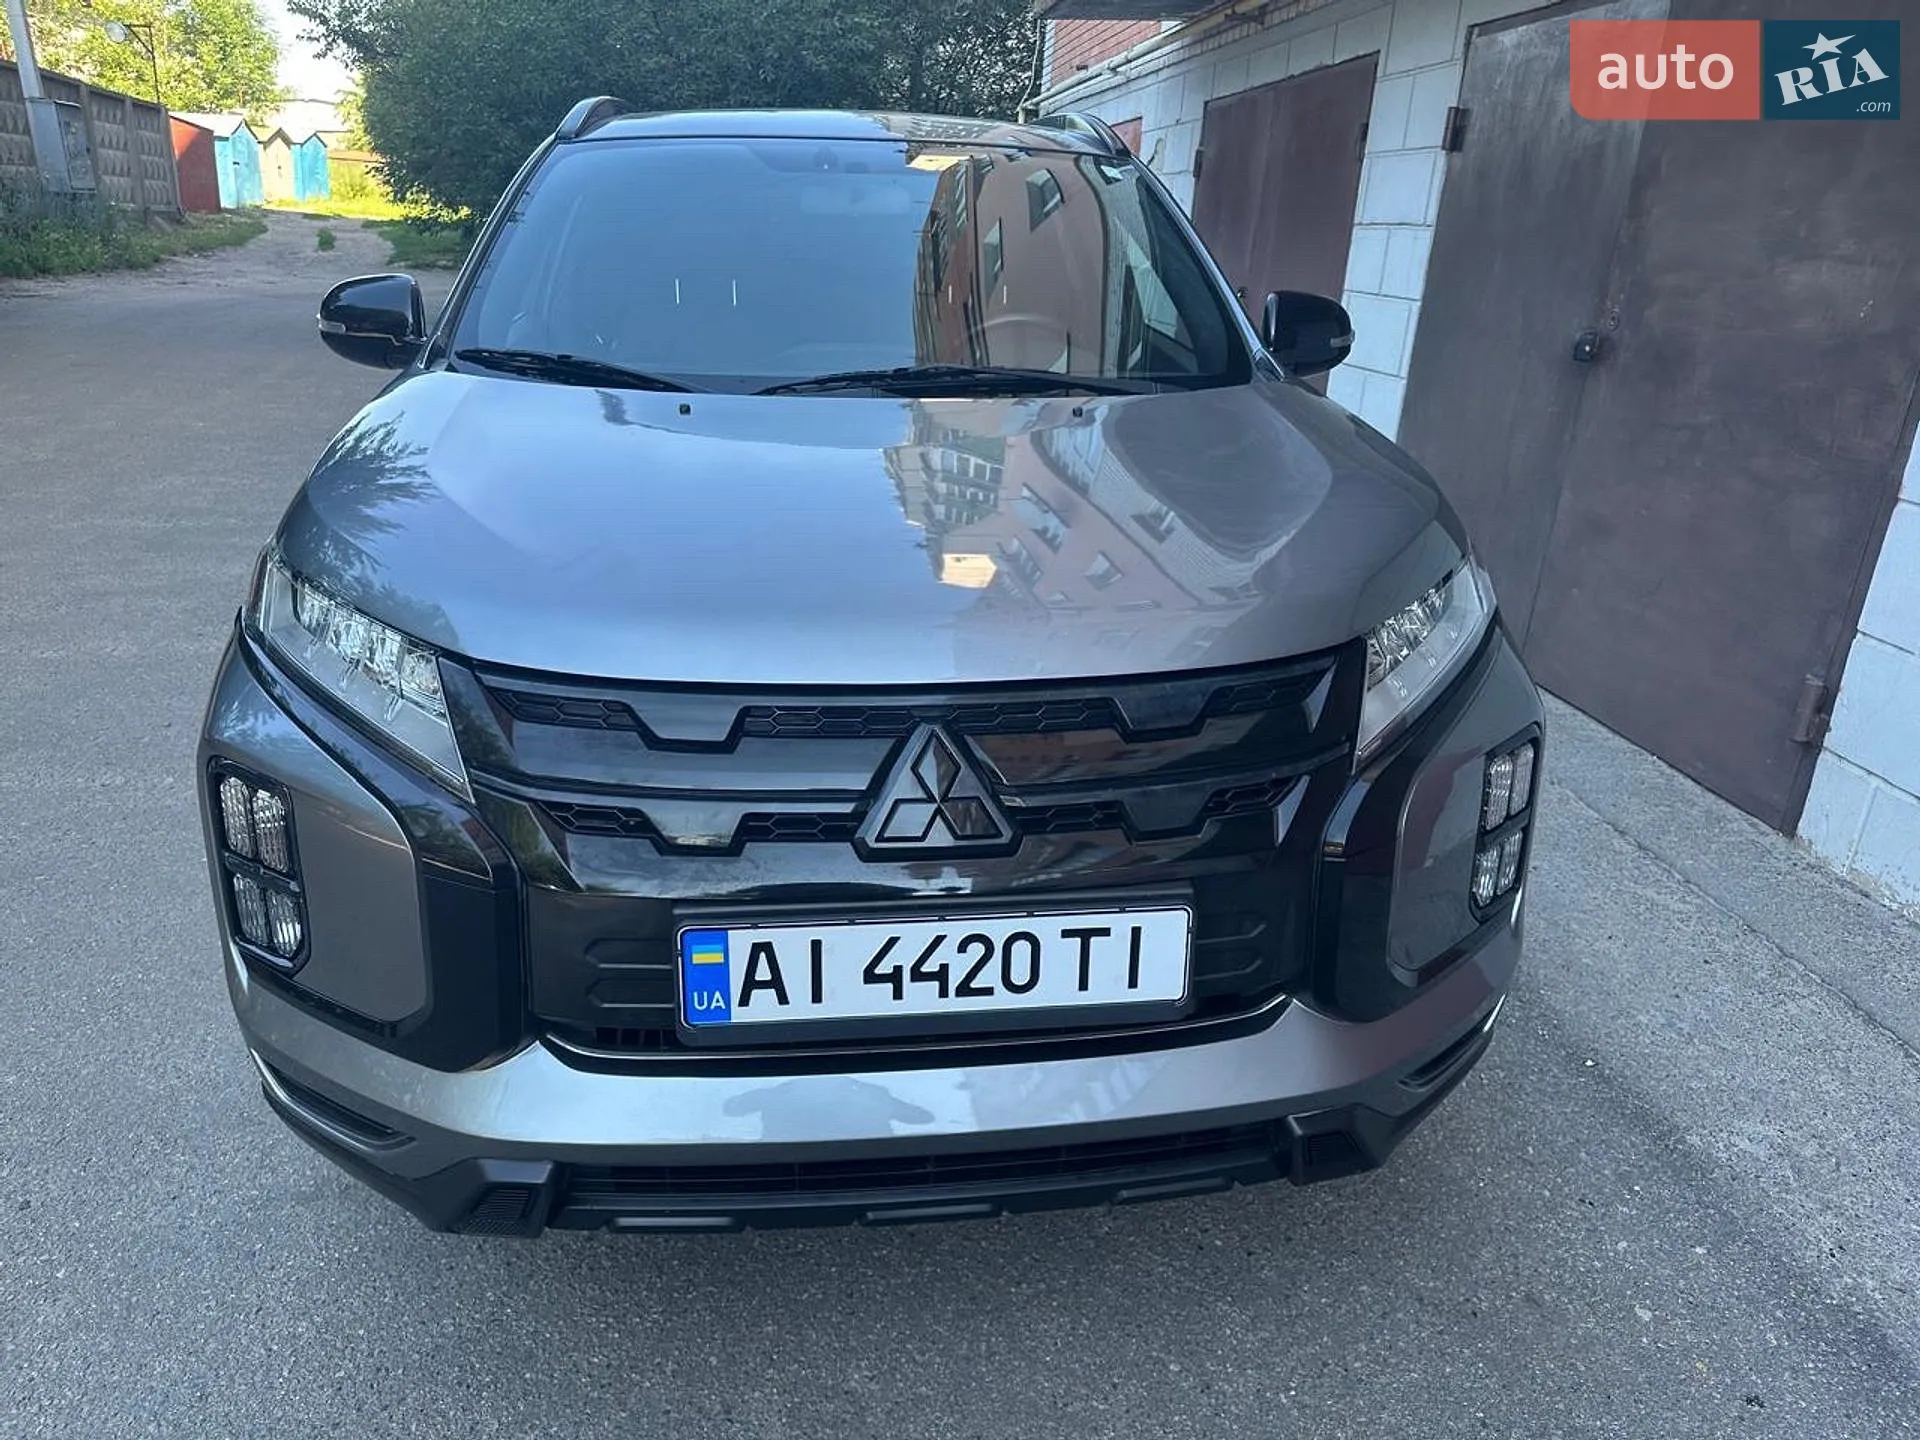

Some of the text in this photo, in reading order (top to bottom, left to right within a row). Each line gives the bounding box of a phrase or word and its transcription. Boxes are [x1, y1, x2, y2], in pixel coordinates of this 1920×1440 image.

[737, 926, 1142, 1008] AI 4420 TI
[693, 990, 726, 1010] UA
